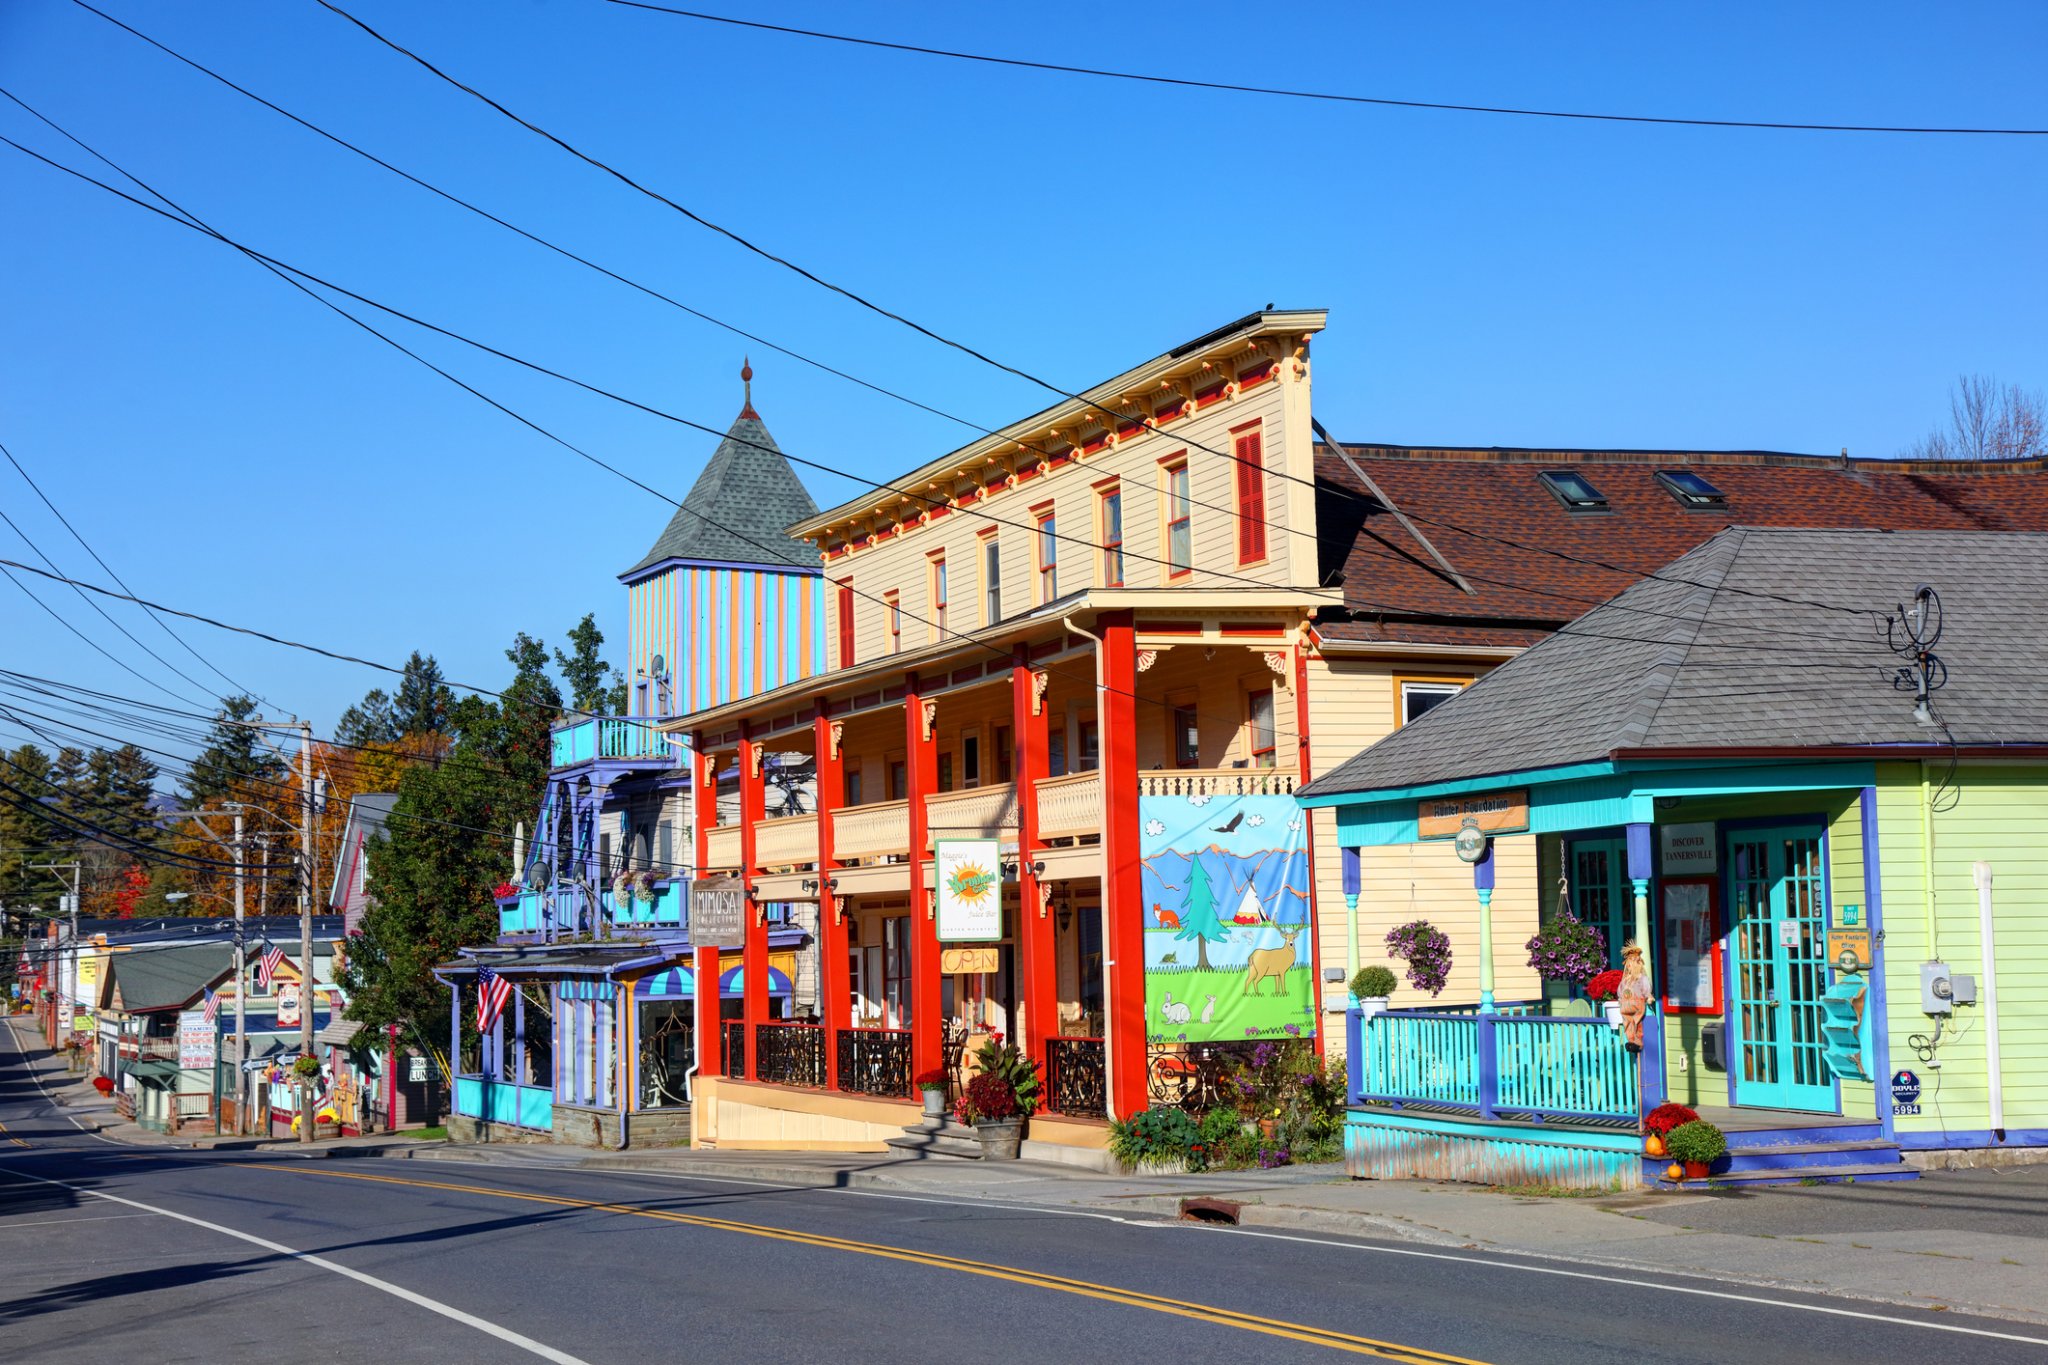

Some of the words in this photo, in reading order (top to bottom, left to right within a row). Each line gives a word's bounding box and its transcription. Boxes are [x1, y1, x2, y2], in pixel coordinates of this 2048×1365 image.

[1434, 805, 1459, 817] Hunter
[1463, 799, 1508, 814] Foundation
[1672, 836, 1704, 847] DISCOVER
[1665, 850, 1712, 860] TANNERSVILLE
[946, 872, 996, 894] Krooked
[697, 892, 736, 914] MIMOSA
[1844, 912, 1857, 921] 5994
[944, 950, 996, 971] OPEN
[411, 1070, 438, 1080] LUNCH
[1894, 1105, 1919, 1115] 5994
